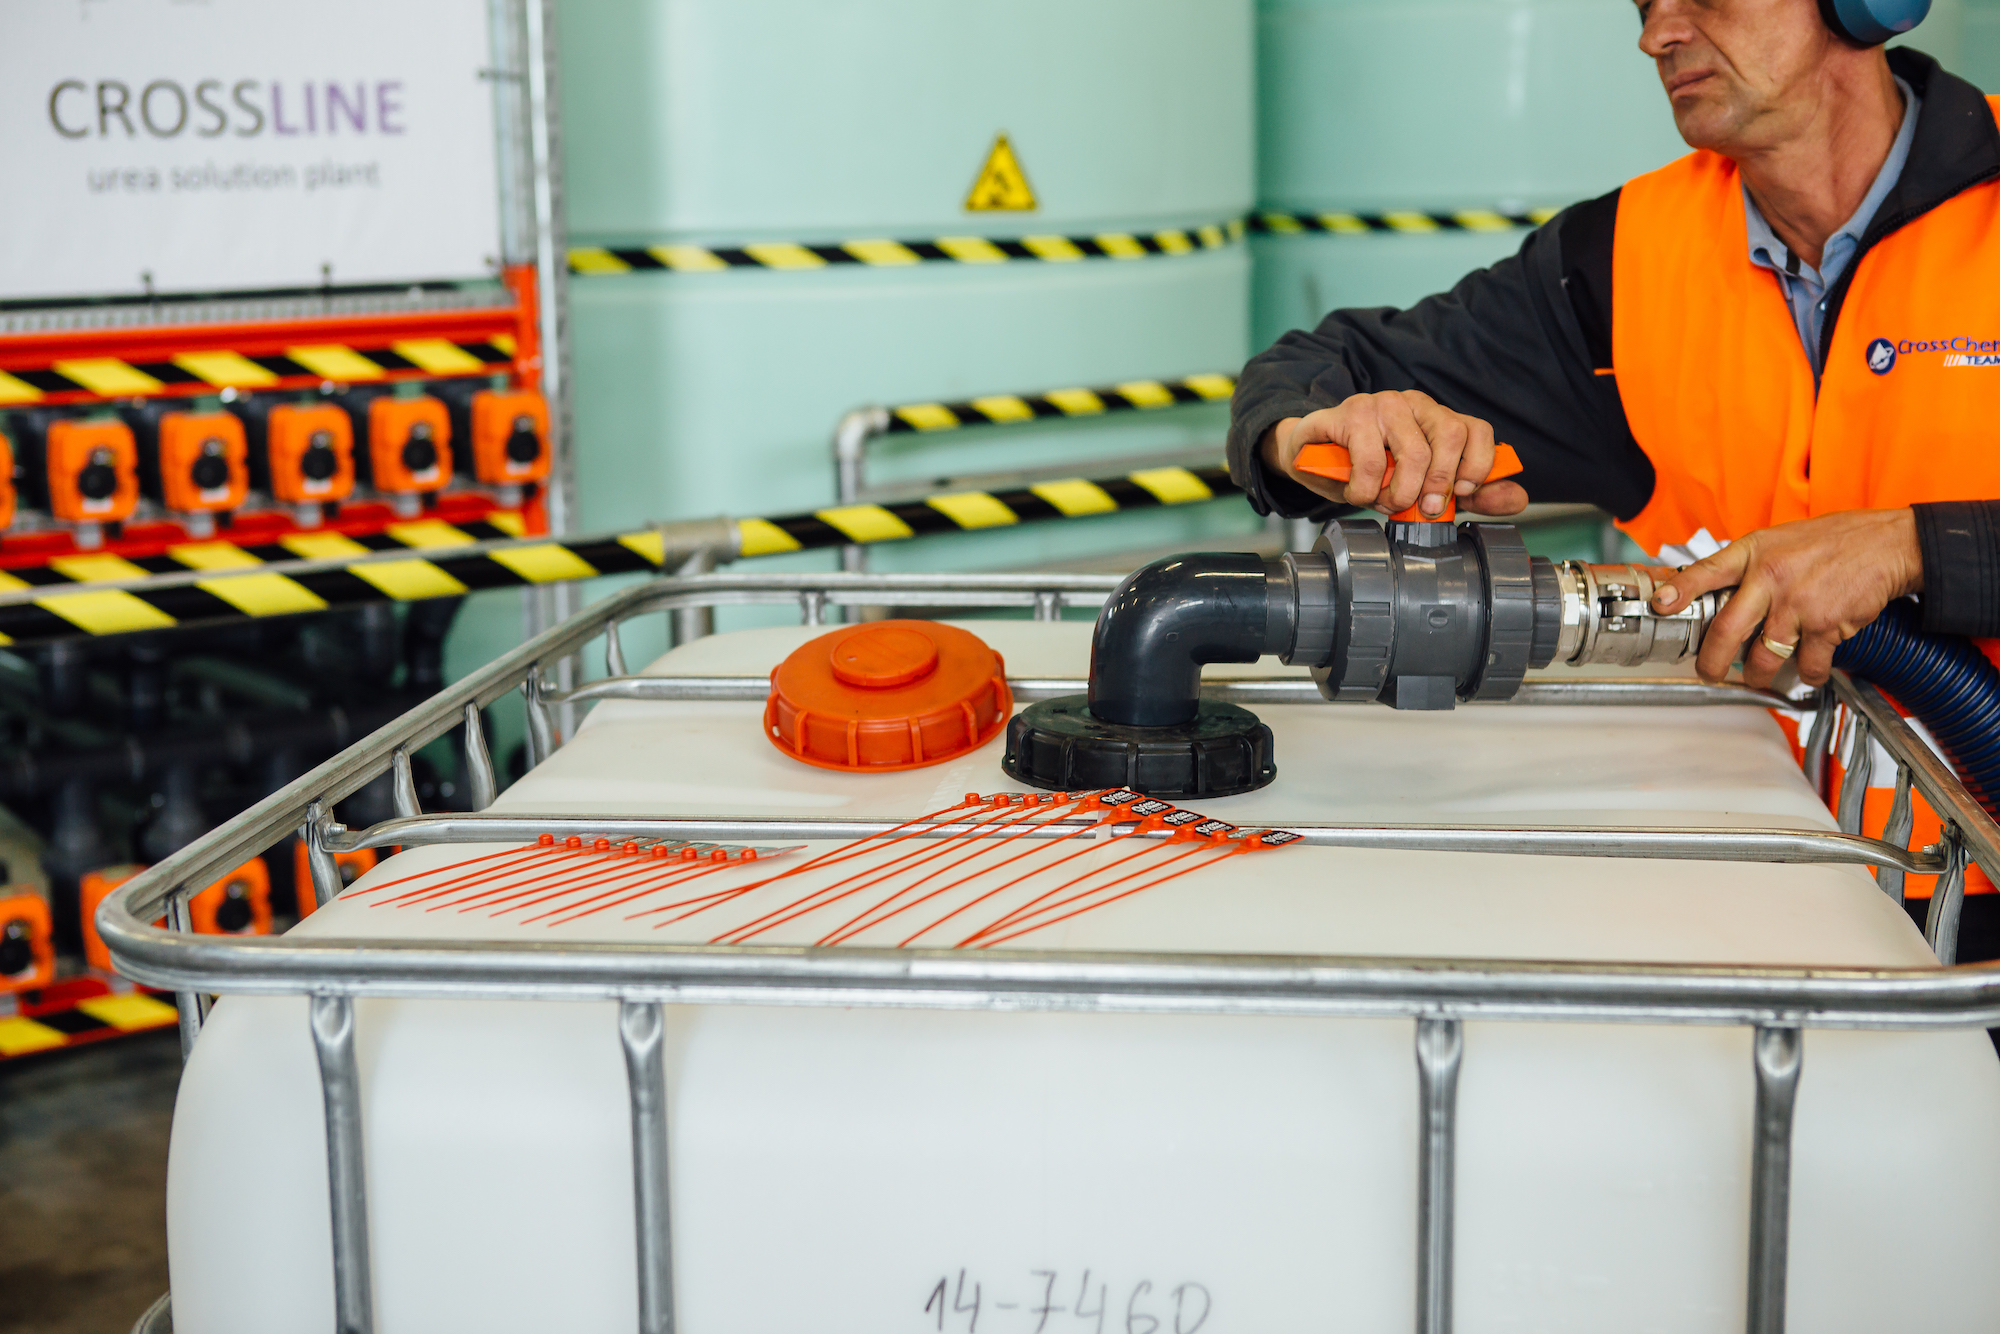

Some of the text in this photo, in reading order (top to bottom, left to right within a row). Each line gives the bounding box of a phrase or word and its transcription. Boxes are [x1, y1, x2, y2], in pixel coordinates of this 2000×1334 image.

[49, 78, 406, 139] CROSSLINE
[88, 156, 380, 193] urea solution plant
